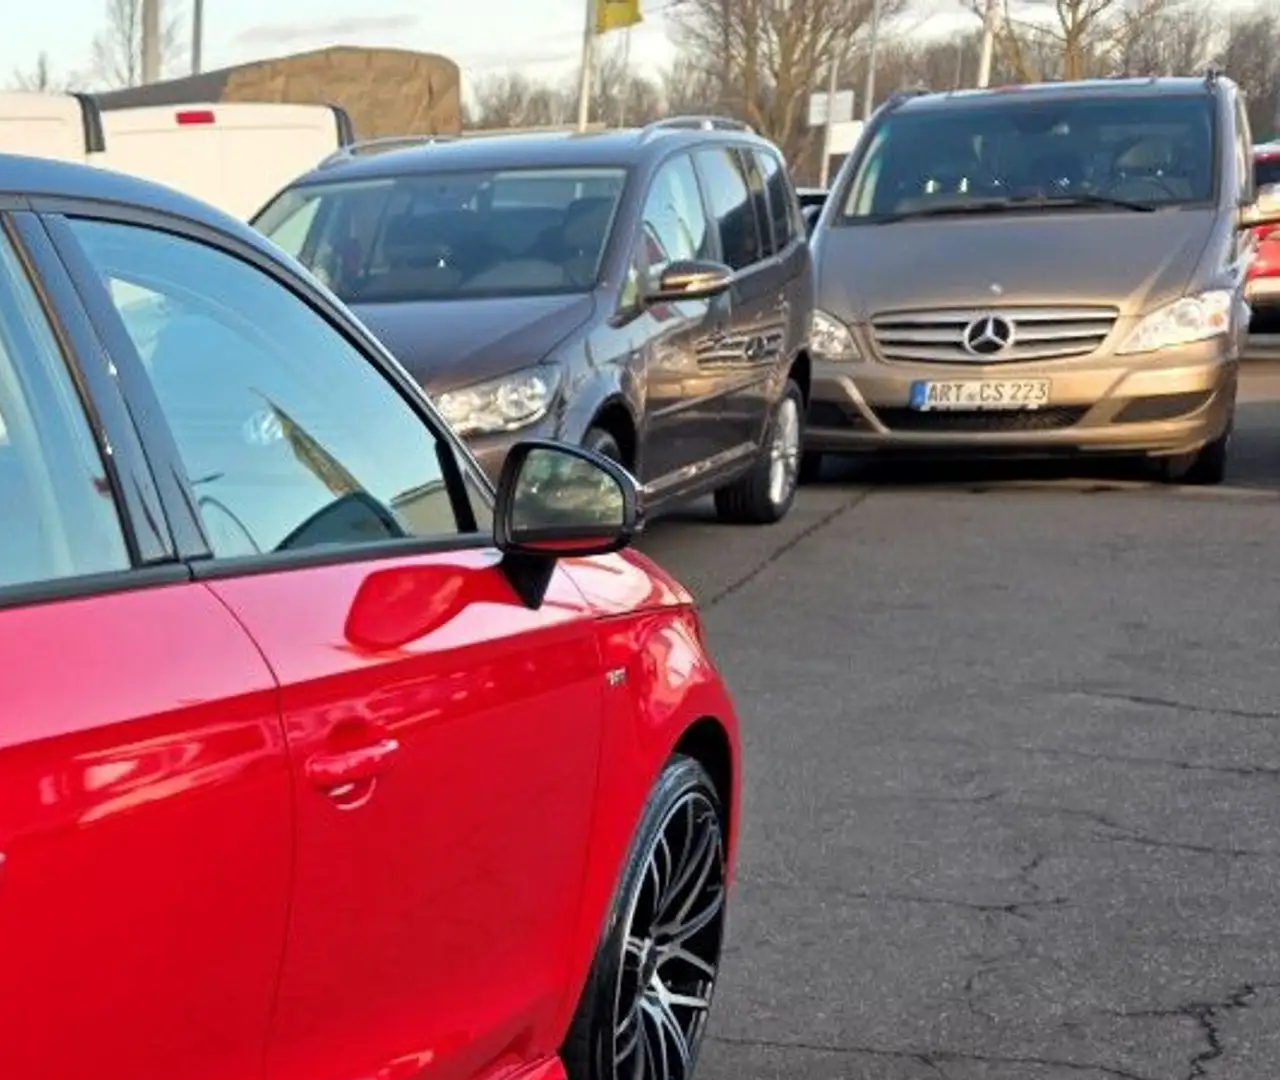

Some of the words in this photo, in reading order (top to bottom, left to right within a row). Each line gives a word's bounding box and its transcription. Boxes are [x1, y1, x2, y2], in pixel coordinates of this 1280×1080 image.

[929, 384, 964, 402] ART
[980, 384, 1005, 401] CS
[1009, 384, 1046, 400] 223
